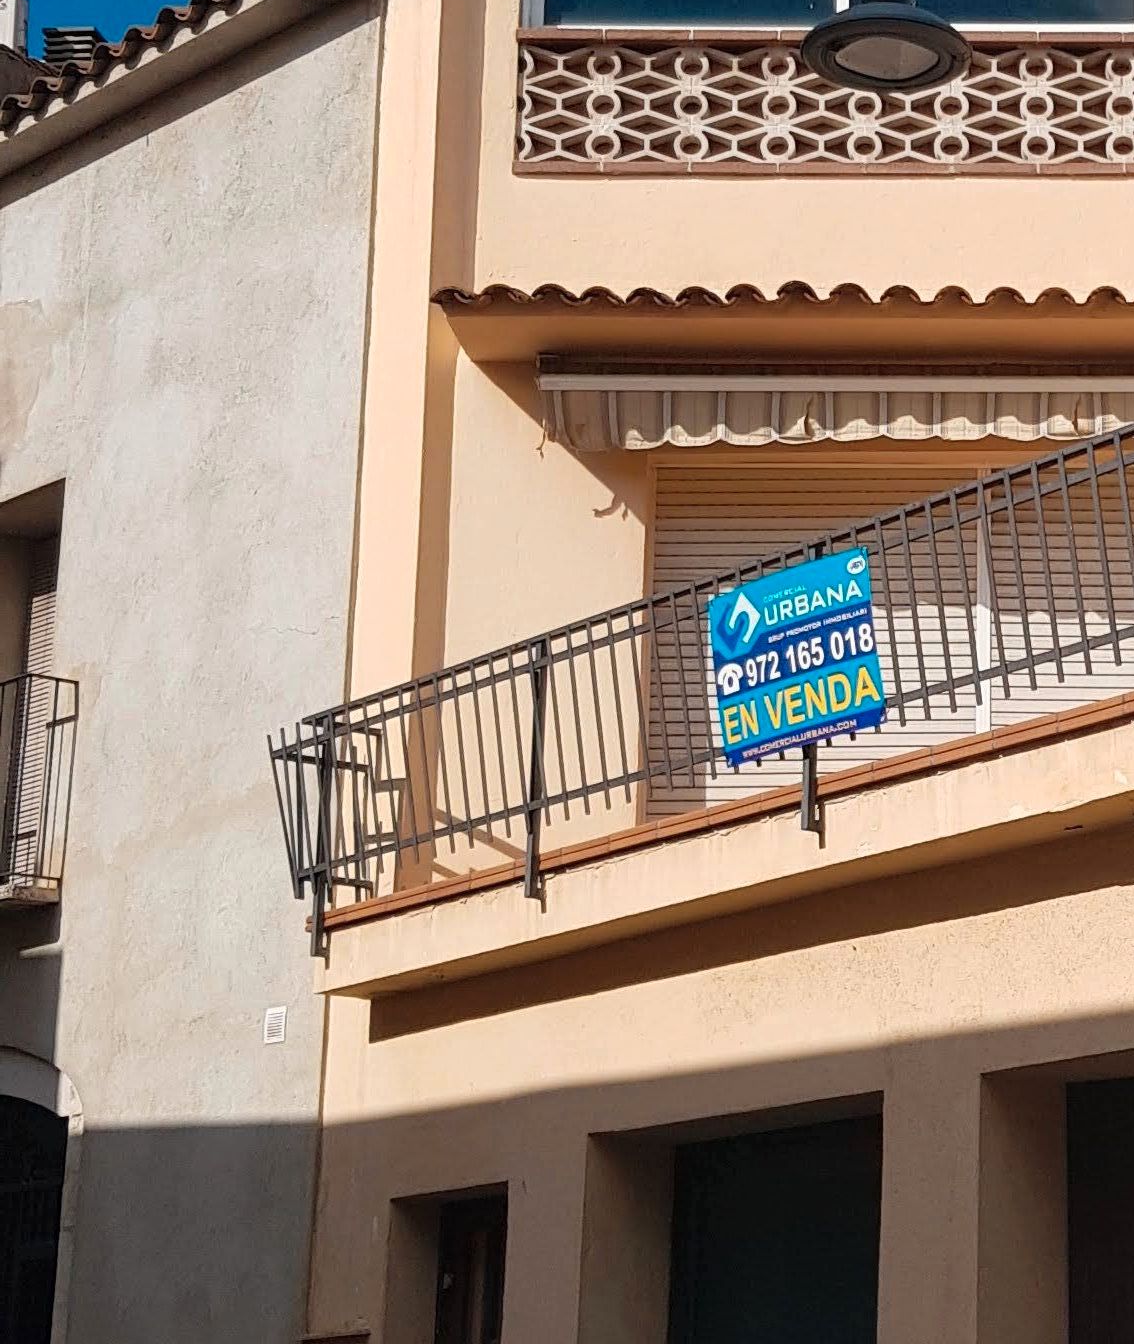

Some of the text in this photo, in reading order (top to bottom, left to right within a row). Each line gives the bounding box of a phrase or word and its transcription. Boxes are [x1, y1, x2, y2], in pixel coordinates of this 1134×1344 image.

[764, 579, 863, 626] URBANA
[745, 623, 874, 687] 972 165 018
[723, 666, 881, 745] EN VENDA
